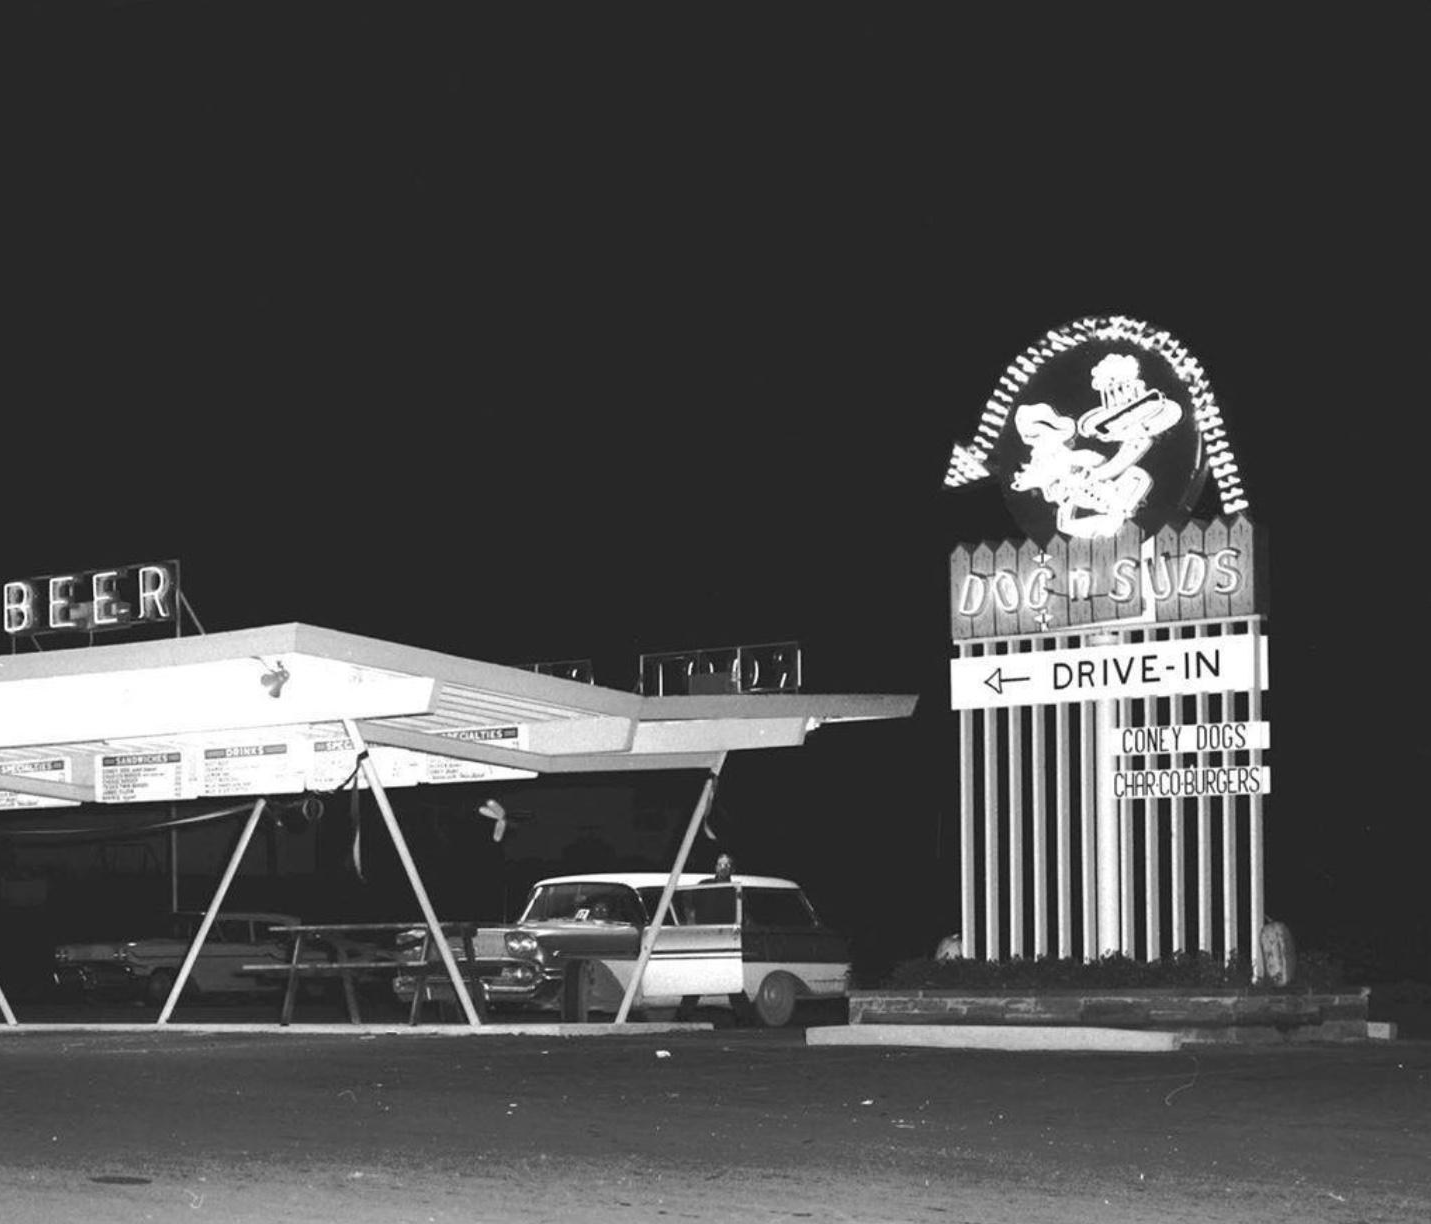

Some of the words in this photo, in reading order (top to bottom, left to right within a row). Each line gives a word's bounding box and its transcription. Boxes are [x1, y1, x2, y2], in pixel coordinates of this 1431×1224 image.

[3, 566, 171, 634] BEER
[958, 566, 1055, 616] DOG
[1108, 547, 1242, 602] SUDS
[1052, 649, 1222, 691] DRIVE-IN
[225, 745, 265, 758] DRINKS
[1121, 726, 1182, 755] CONEY
[1196, 722, 1248, 752] DOGS
[115, 753, 169, 766] SANDWICHES
